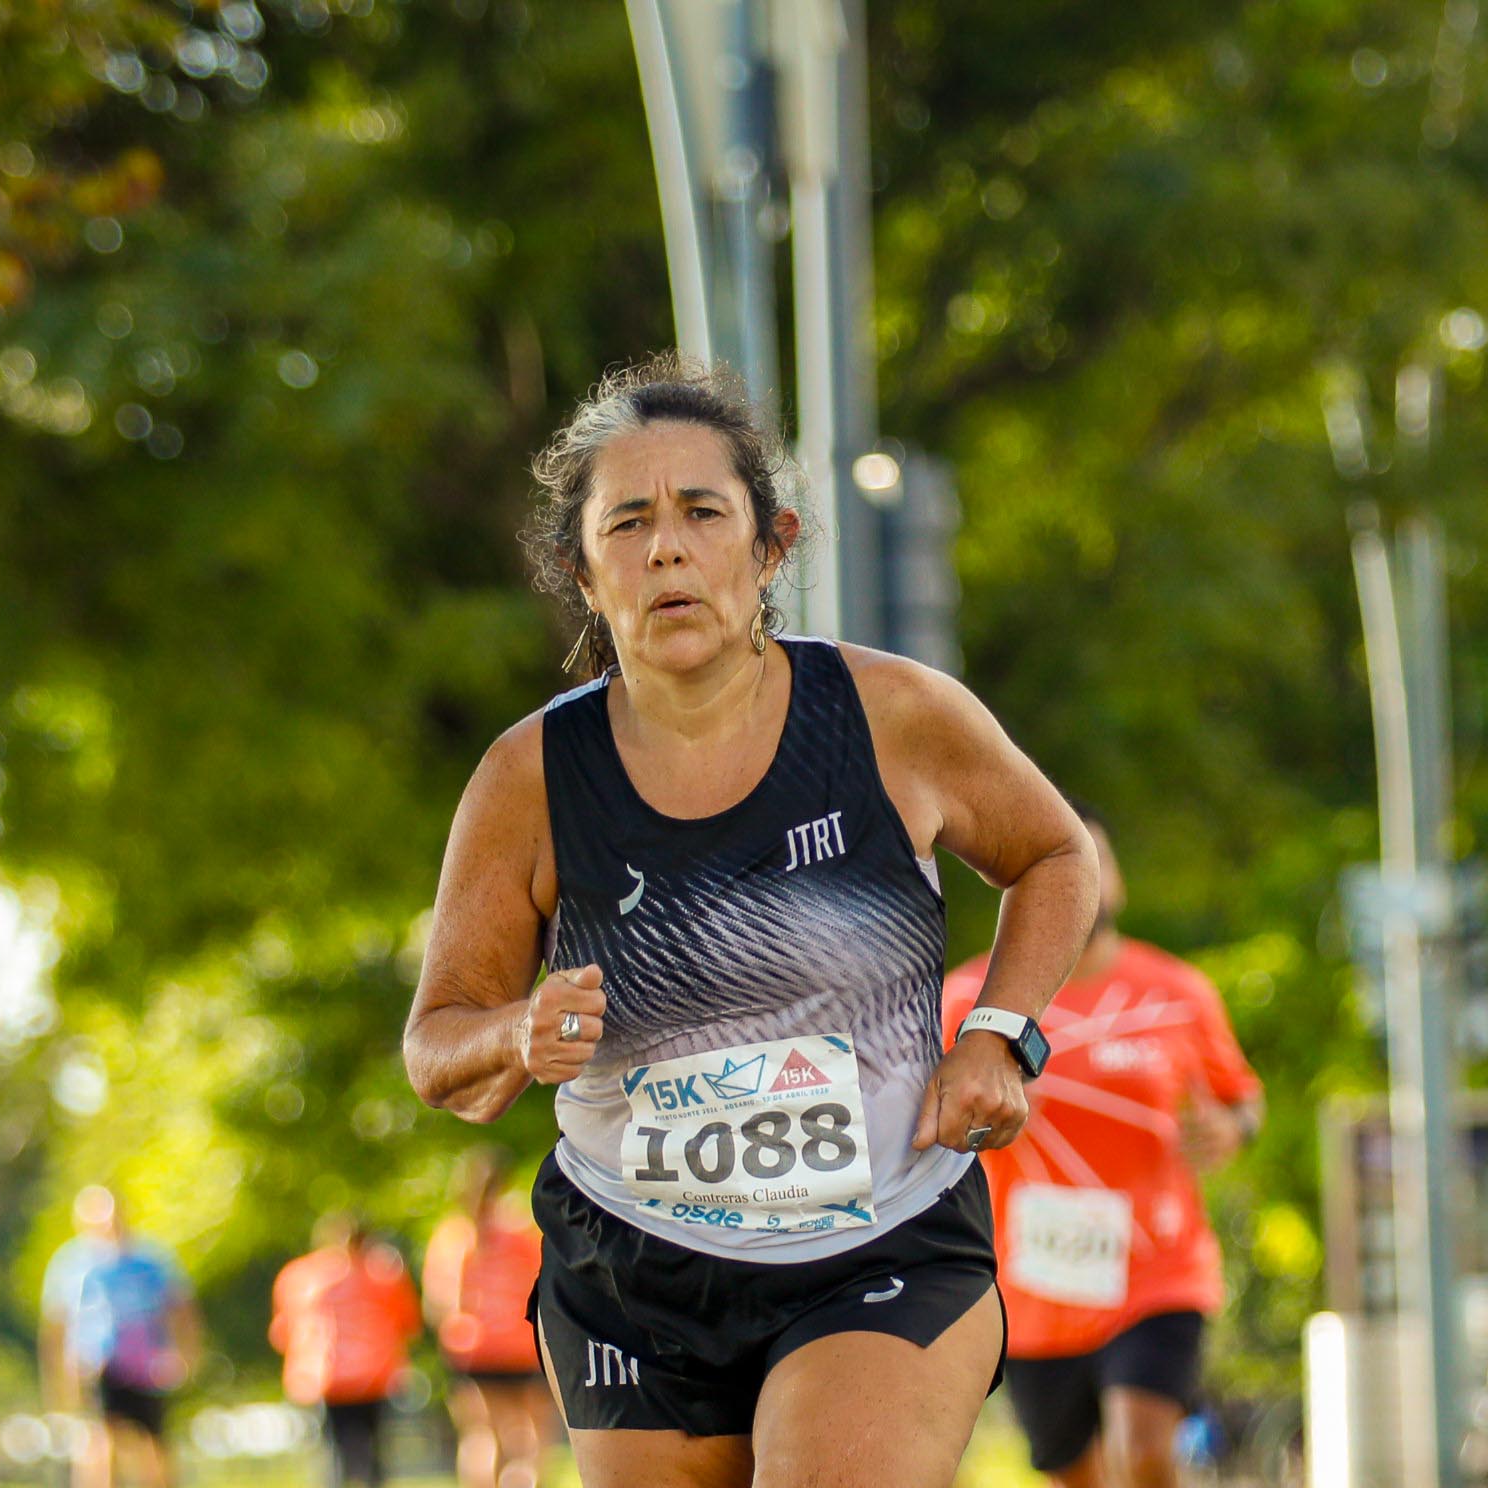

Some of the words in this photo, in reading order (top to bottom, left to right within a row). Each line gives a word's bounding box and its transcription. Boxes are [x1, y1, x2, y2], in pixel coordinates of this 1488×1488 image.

[785, 811, 847, 872] JTRT
[780, 1066, 817, 1086] 15K
[643, 1074, 706, 1112] 15K
[724, 1100, 755, 1110] ROSARIO
[635, 1102, 857, 1184] 1088
[682, 1190, 749, 1205] Contreras
[752, 1185, 809, 1203] Claudia
